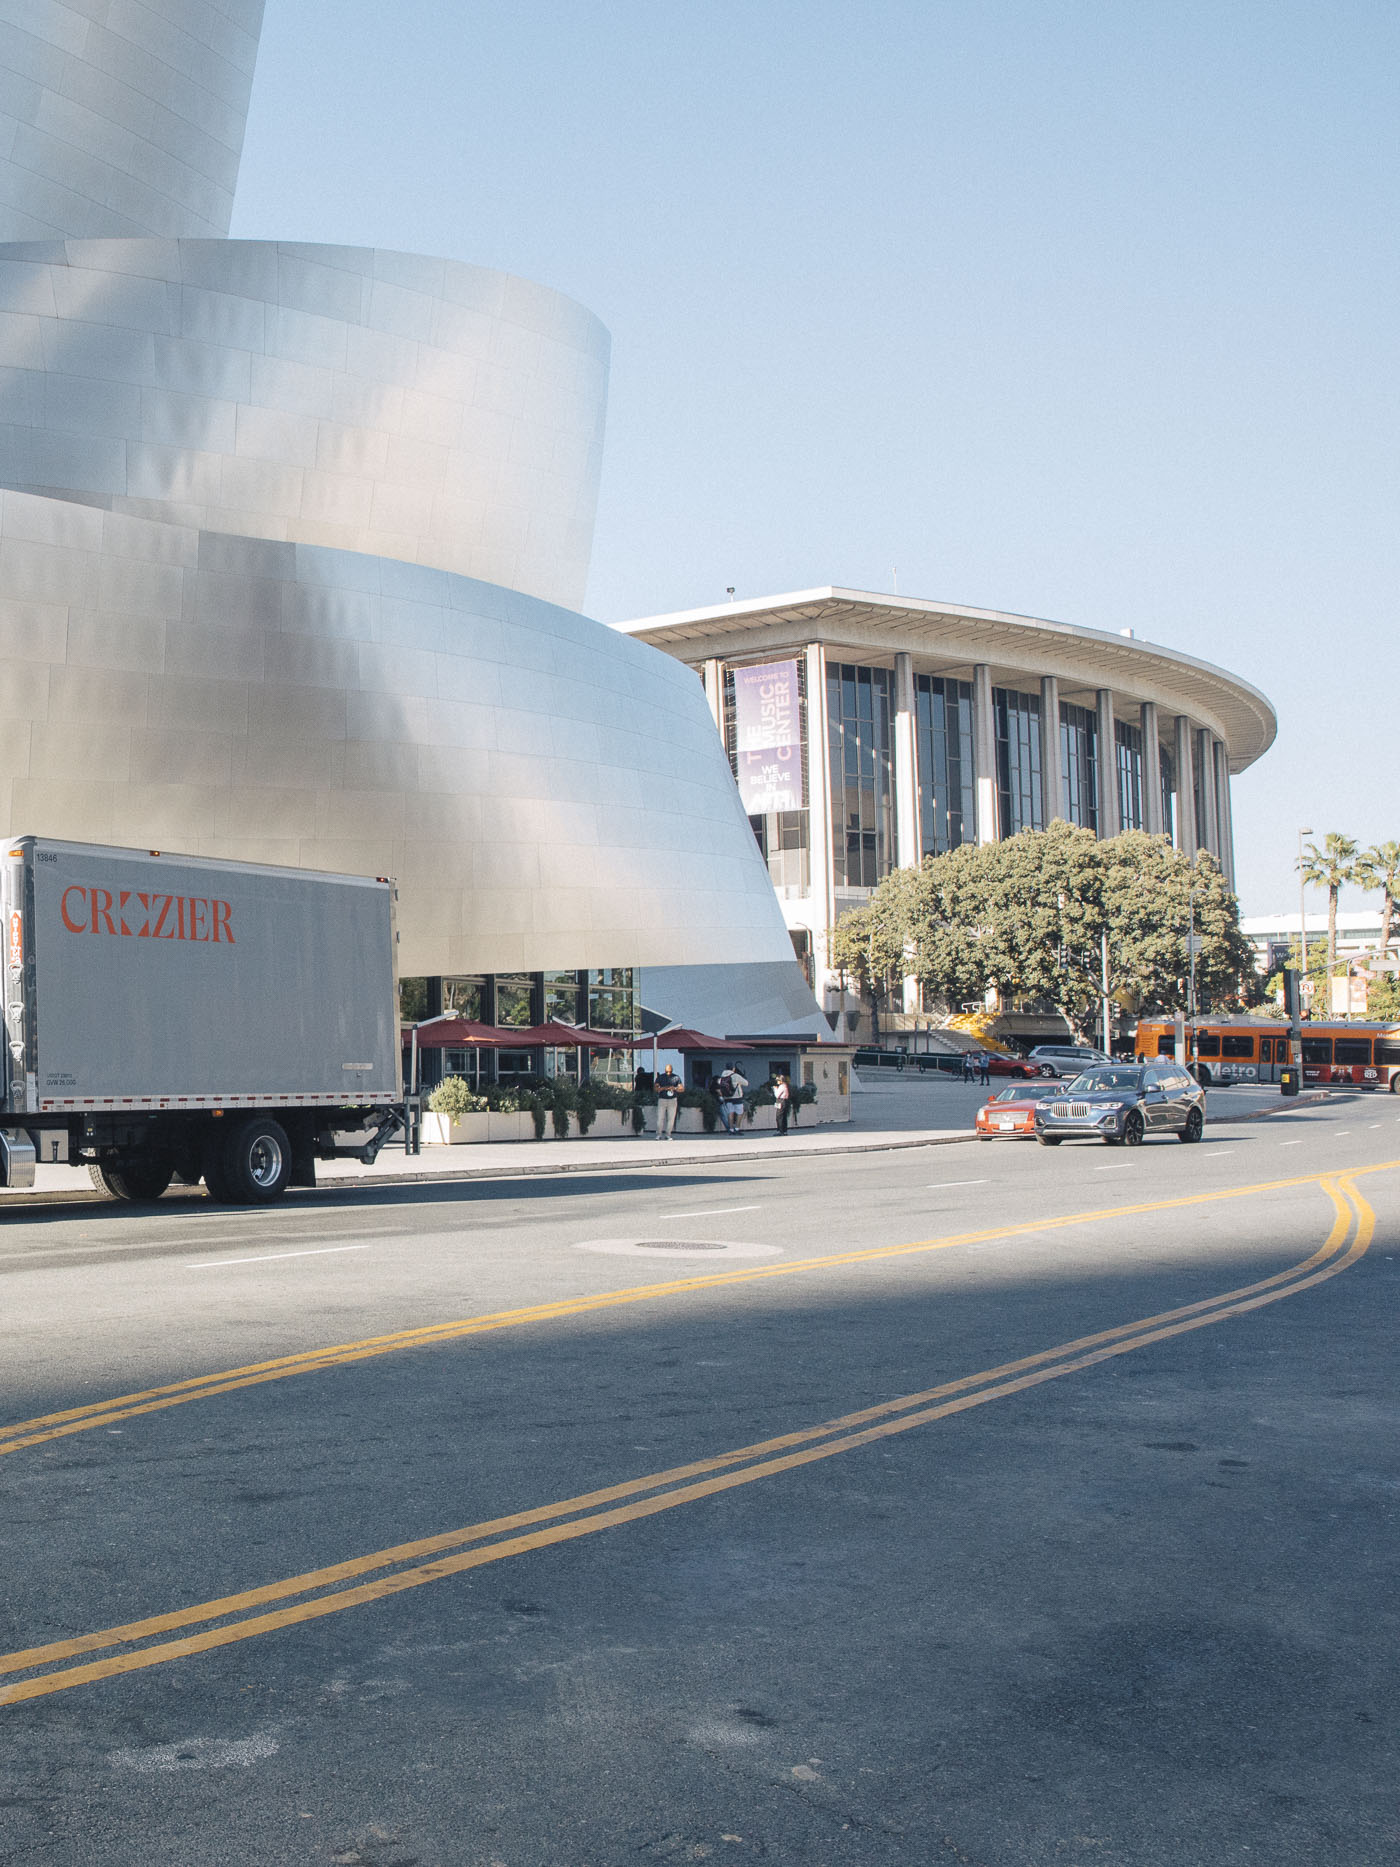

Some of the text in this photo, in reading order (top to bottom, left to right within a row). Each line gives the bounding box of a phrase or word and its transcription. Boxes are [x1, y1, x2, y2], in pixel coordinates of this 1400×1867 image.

[743, 671, 790, 684] WELCOME TO
[760, 682, 776, 748] MUSIC
[775, 680, 792, 761] CENTER
[761, 764, 779, 775] WE
[750, 772, 791, 785] BELIEVE
[36, 852, 58, 863] 13846
[1205, 1062, 1257, 1077] Metro
